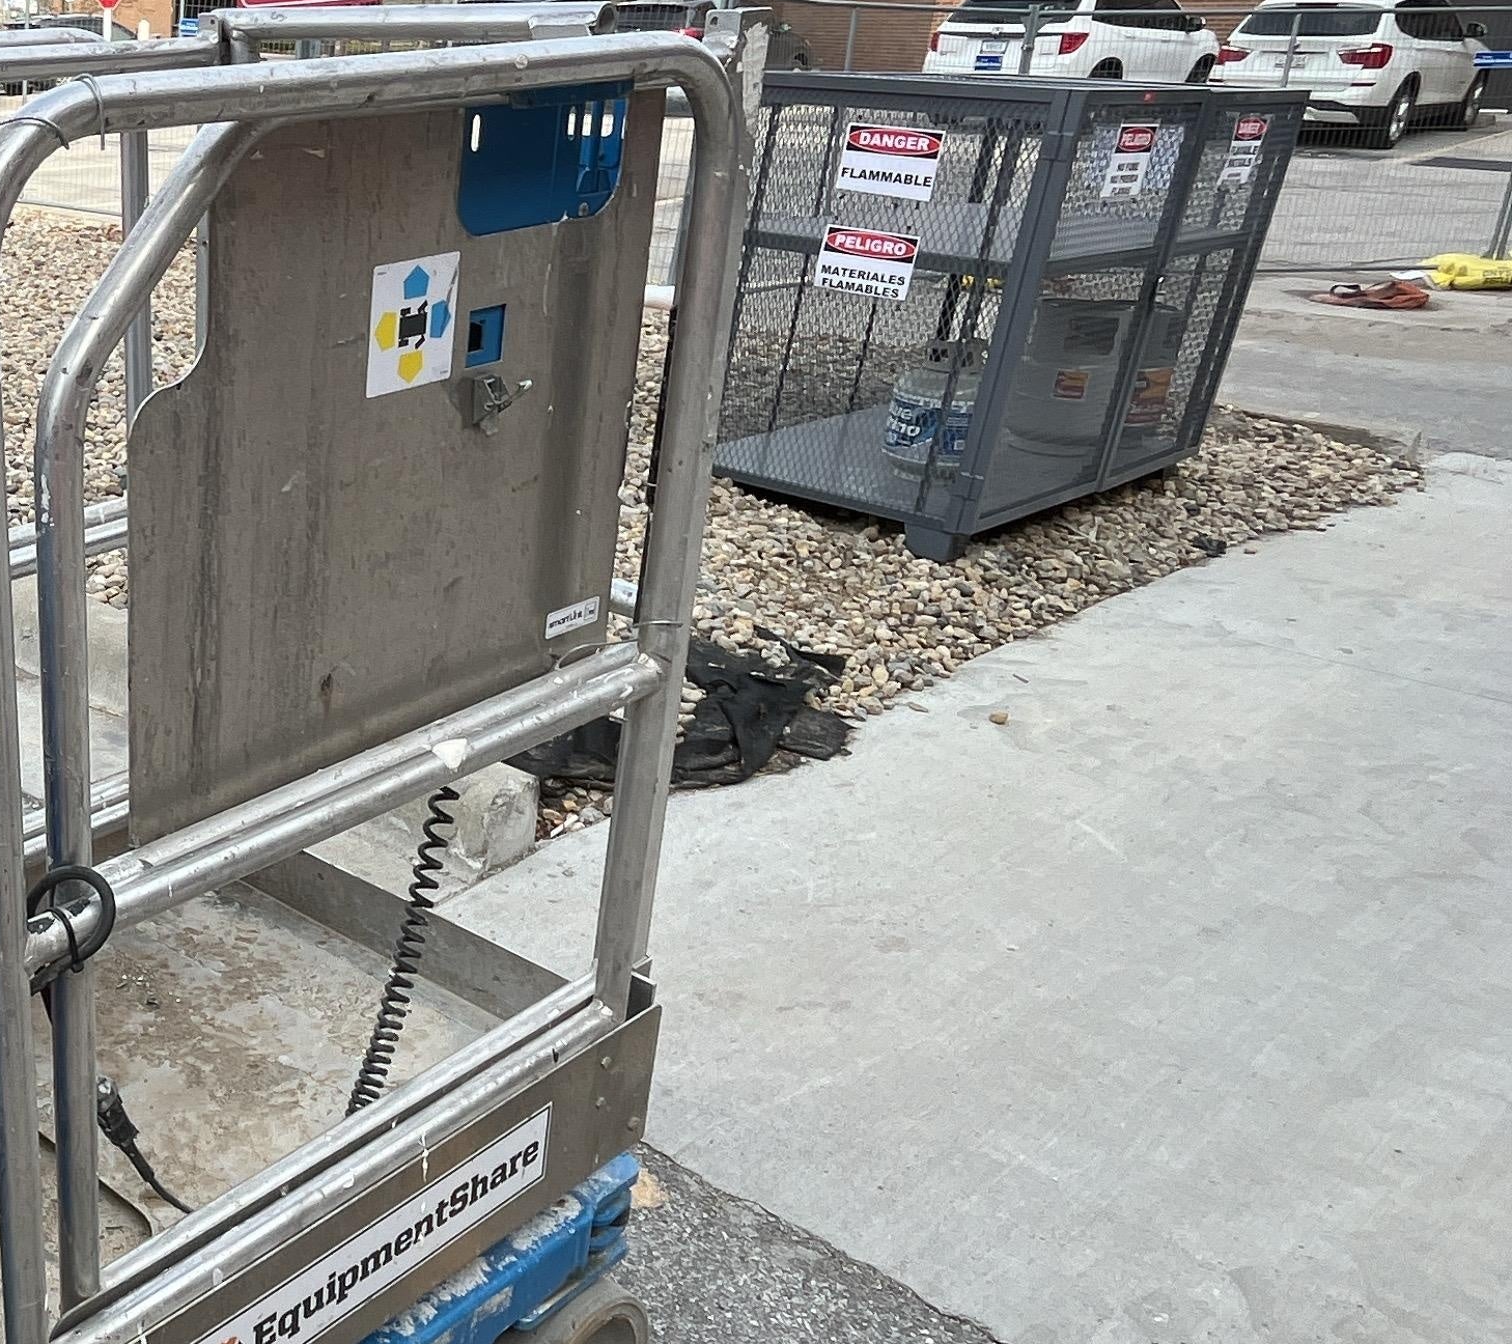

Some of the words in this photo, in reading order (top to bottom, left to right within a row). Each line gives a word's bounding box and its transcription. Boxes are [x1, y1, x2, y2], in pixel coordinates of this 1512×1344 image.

[859, 132, 929, 150] DANGER
[841, 167, 932, 187] FLAMMABLE
[835, 234, 906, 255] PELIGRO
[821, 265, 905, 285] MATERIALES
[822, 278, 899, 298] FLAMABLES
